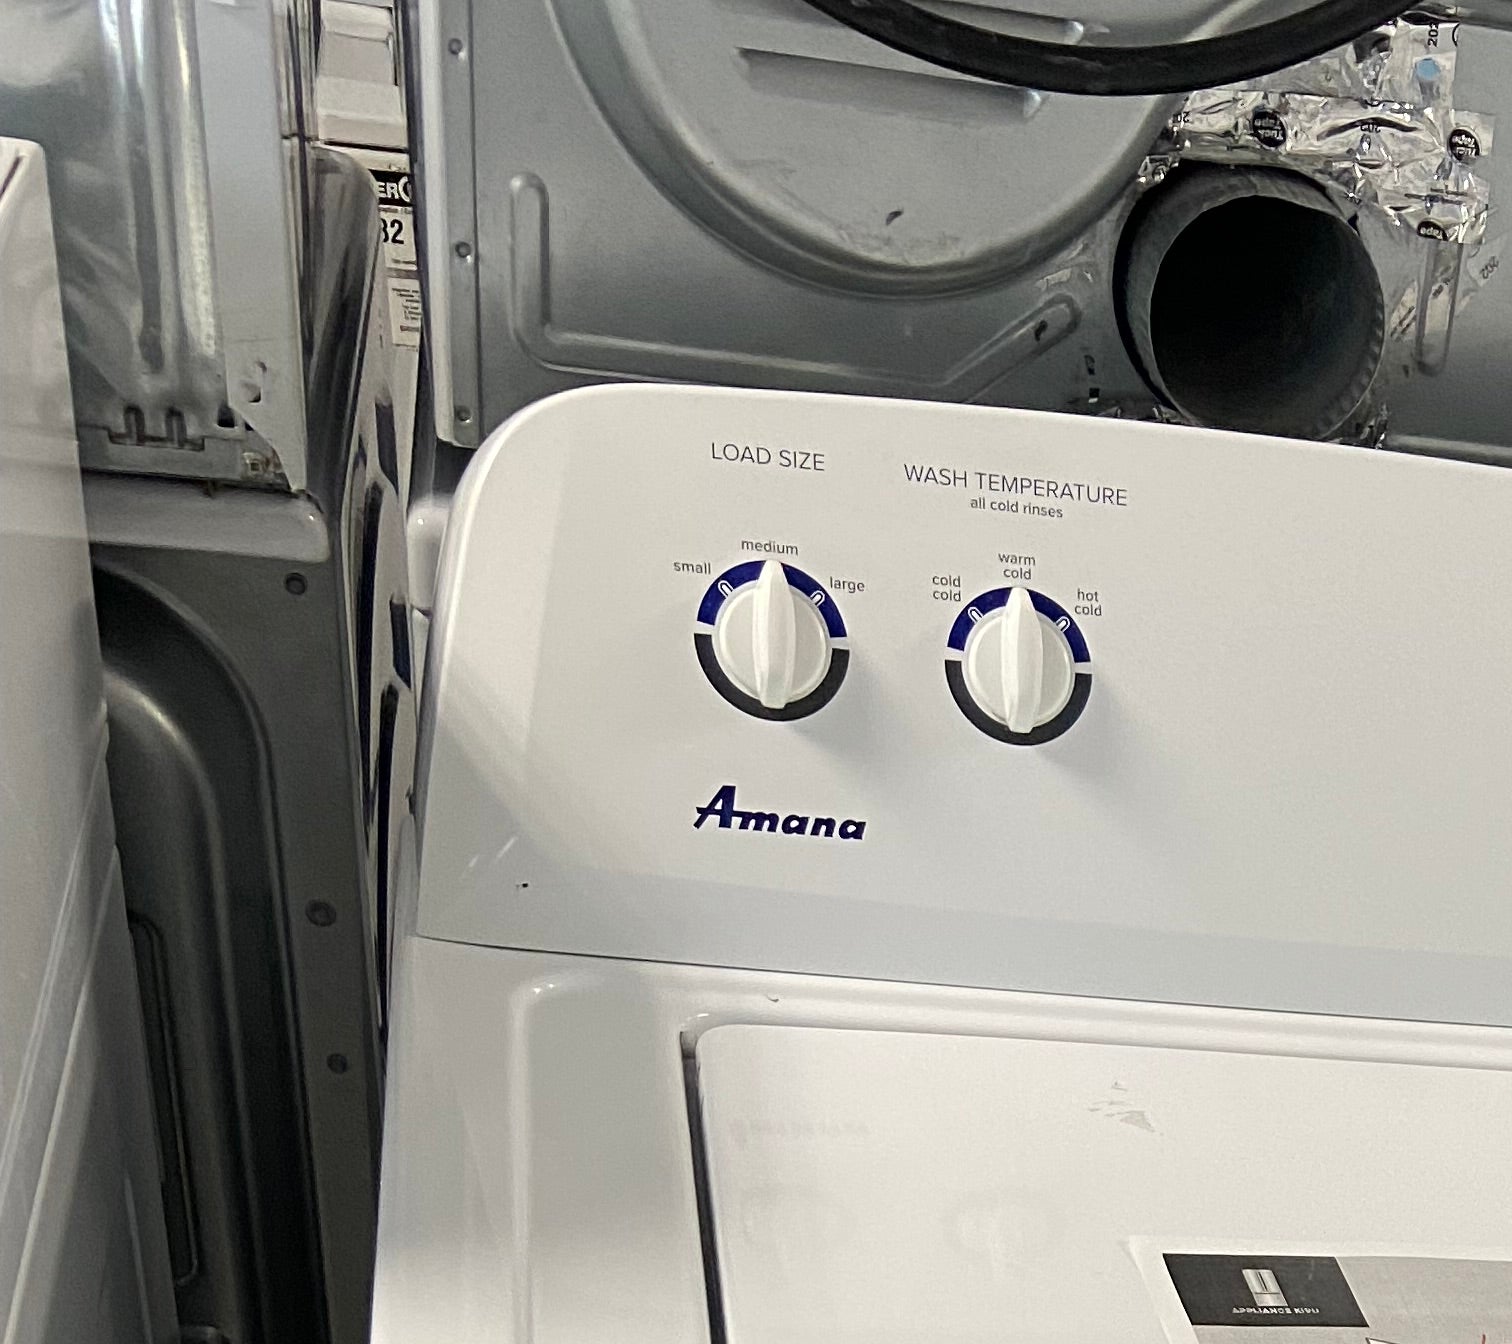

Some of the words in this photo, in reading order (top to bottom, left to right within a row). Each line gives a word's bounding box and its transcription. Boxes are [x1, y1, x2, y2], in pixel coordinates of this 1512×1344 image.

[710, 442, 772, 467] LOAD
[778, 449, 826, 472] SIZE
[903, 464, 968, 490] WASH
[973, 472, 1128, 507] TEMPERATURE
[970, 497, 986, 511] all
[989, 500, 1019, 515] cold
[1022, 503, 1064, 519] rinses
[741, 539, 799, 557] medium
[673, 559, 712, 576] small
[997, 552, 1037, 568] warm
[931, 572, 962, 588] cold
[1003, 566, 1032, 581] cold
[829, 576, 866, 594] large
[932, 587, 962, 603] cold
[1076, 587, 1099, 603] hot
[1074, 602, 1103, 617] cold
[691, 785, 867, 841] Amana
